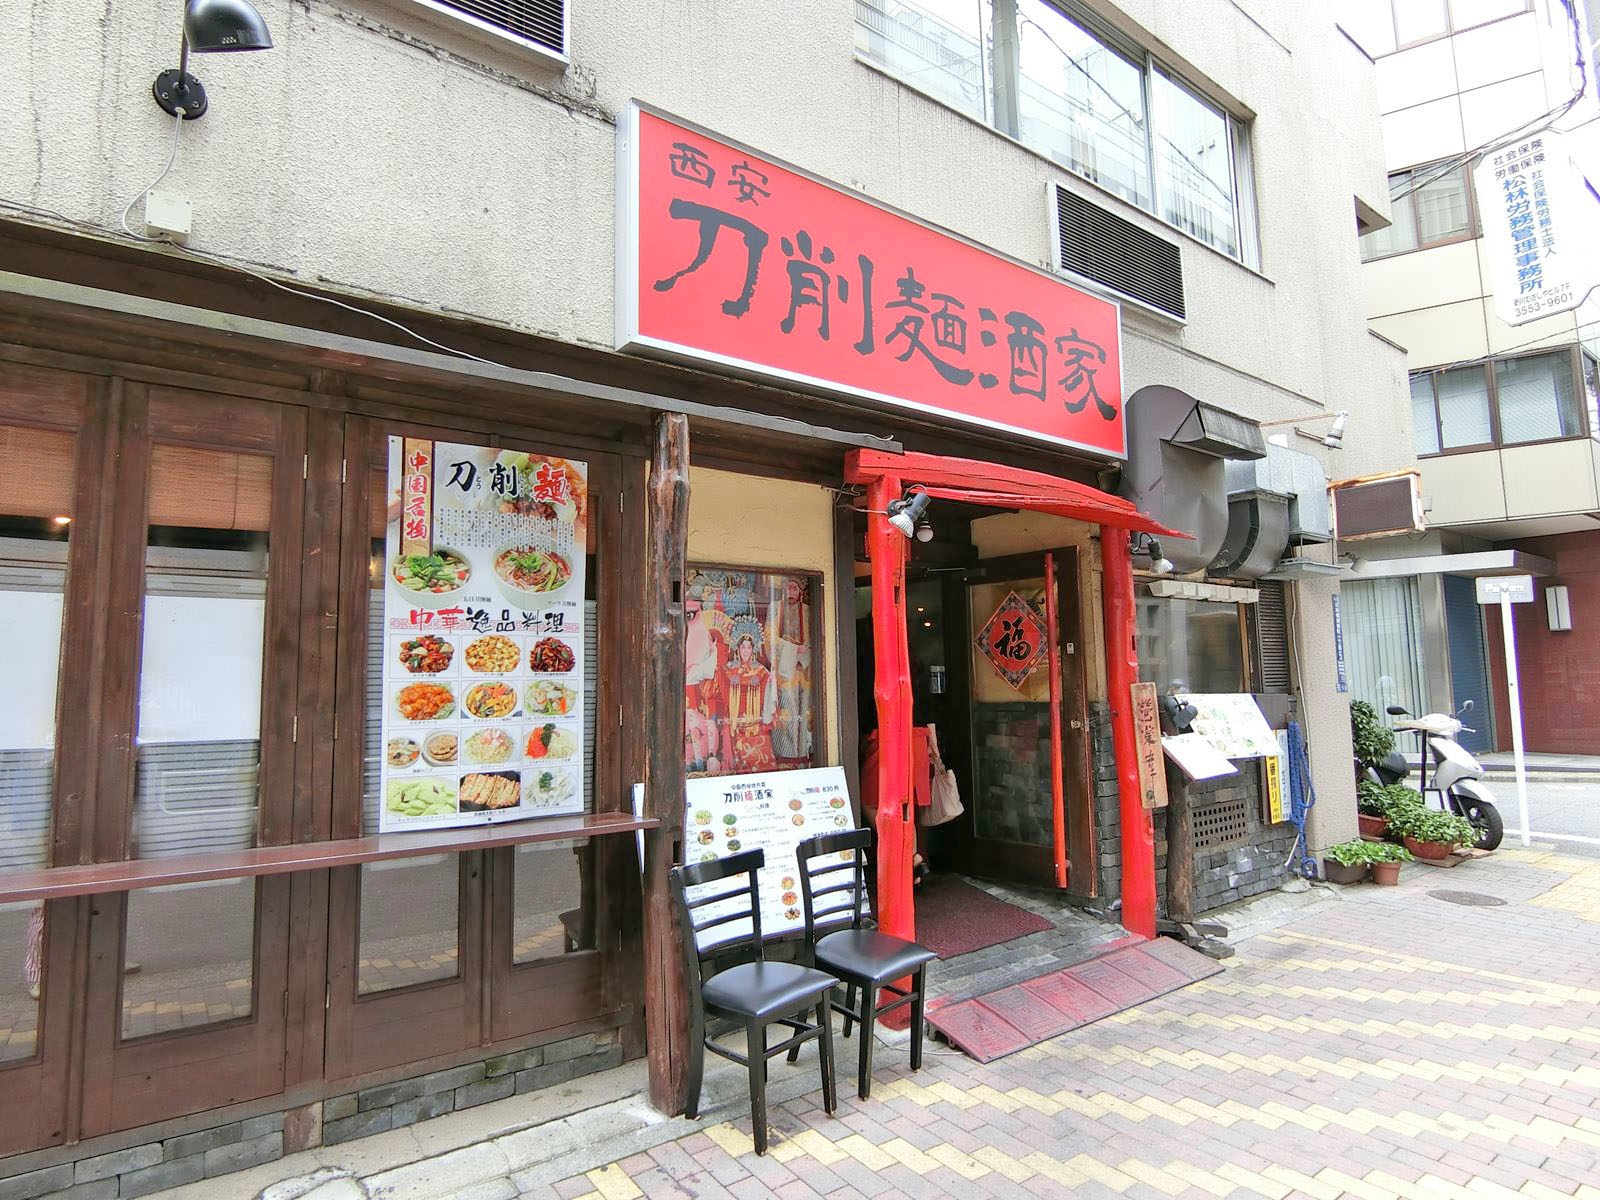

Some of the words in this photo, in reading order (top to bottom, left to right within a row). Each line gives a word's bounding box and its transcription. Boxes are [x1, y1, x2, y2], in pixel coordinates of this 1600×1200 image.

[669, 142, 771, 206] 西安
[1493, 139, 1544, 165] 社会保険
[1495, 153, 1546, 180] 労働保険
[1502, 175, 1544, 295] 松林労務管理事務所
[1531, 170, 1557, 259] 社会保険労務士法人
[653, 198, 1117, 421] 刀削麺酒家
[1514, 292, 1574, 317] 3553-9601
[405, 451, 428, 540] 中国名物
[445, 460, 567, 506] 刀削麺
[410, 605, 564, 635] 中華逸品料理
[995, 616, 1032, 660] 福
